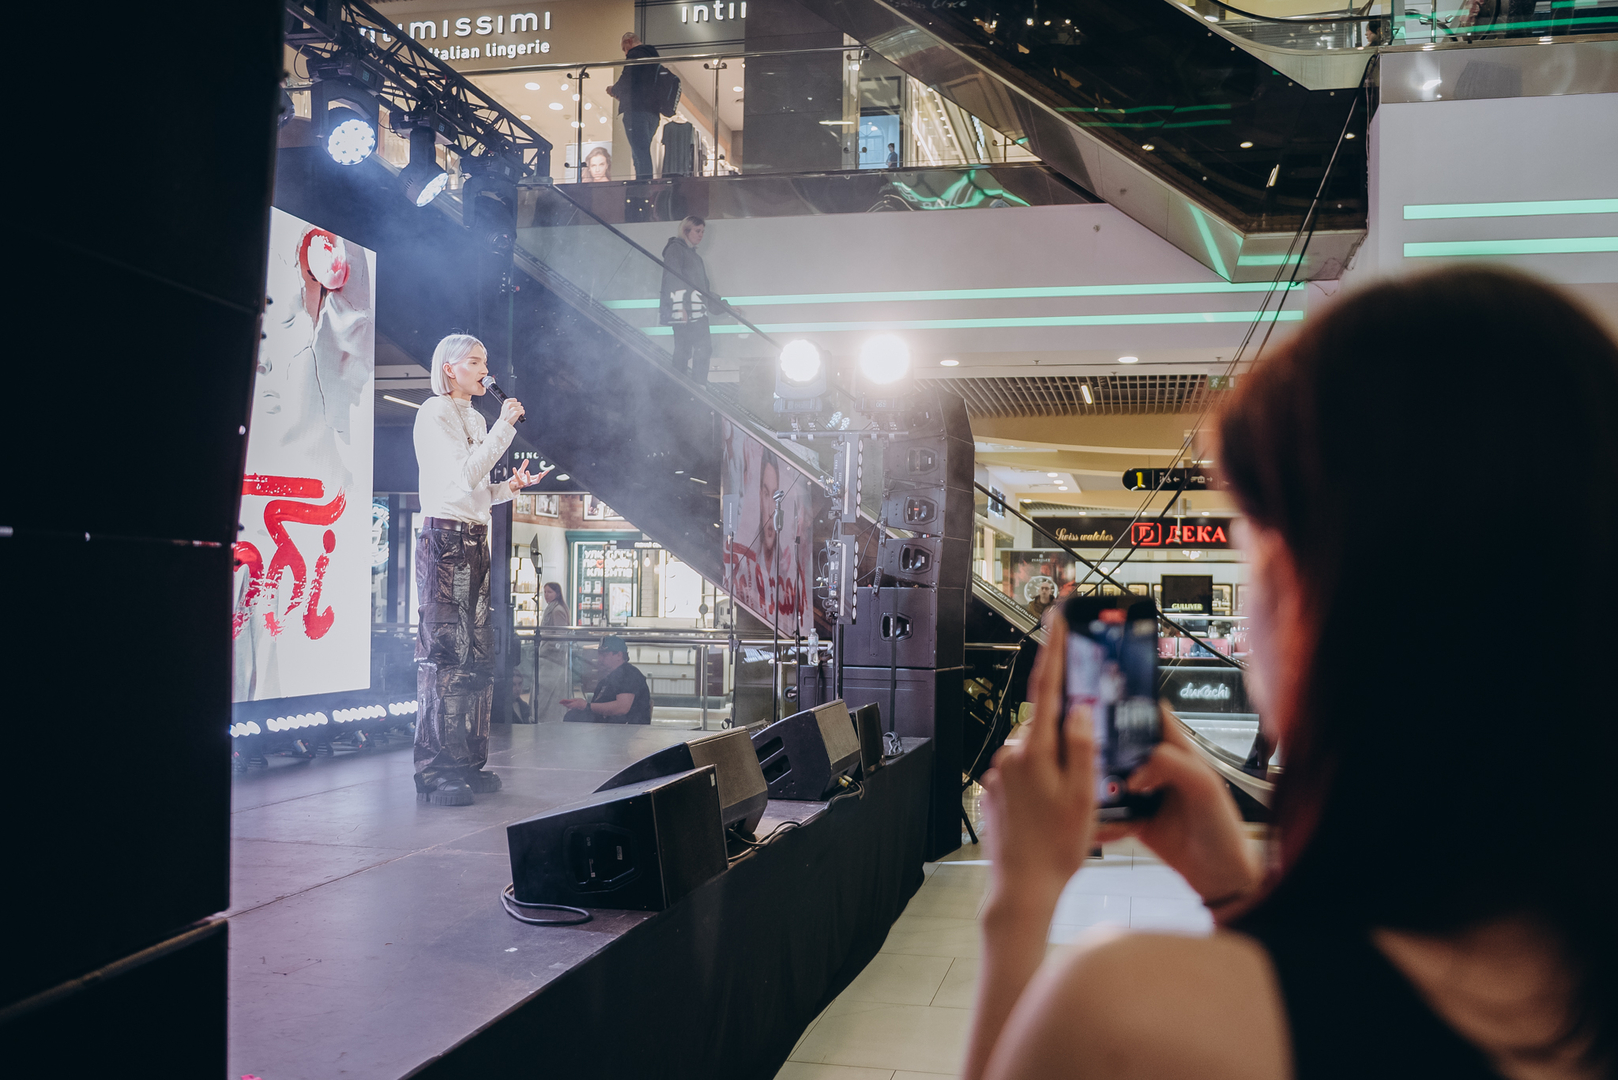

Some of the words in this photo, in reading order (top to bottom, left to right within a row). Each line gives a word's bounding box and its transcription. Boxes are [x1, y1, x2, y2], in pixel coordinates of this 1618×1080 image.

[681, 0, 747, 23] inti
[485, 39, 551, 59] lingerie
[514, 452, 544, 460] SINC
[1136, 472, 1144, 487] 1
[1055, 527, 1079, 541] Swiss
[1080, 529, 1114, 541] watches
[1165, 525, 1227, 545] ДЕКА
